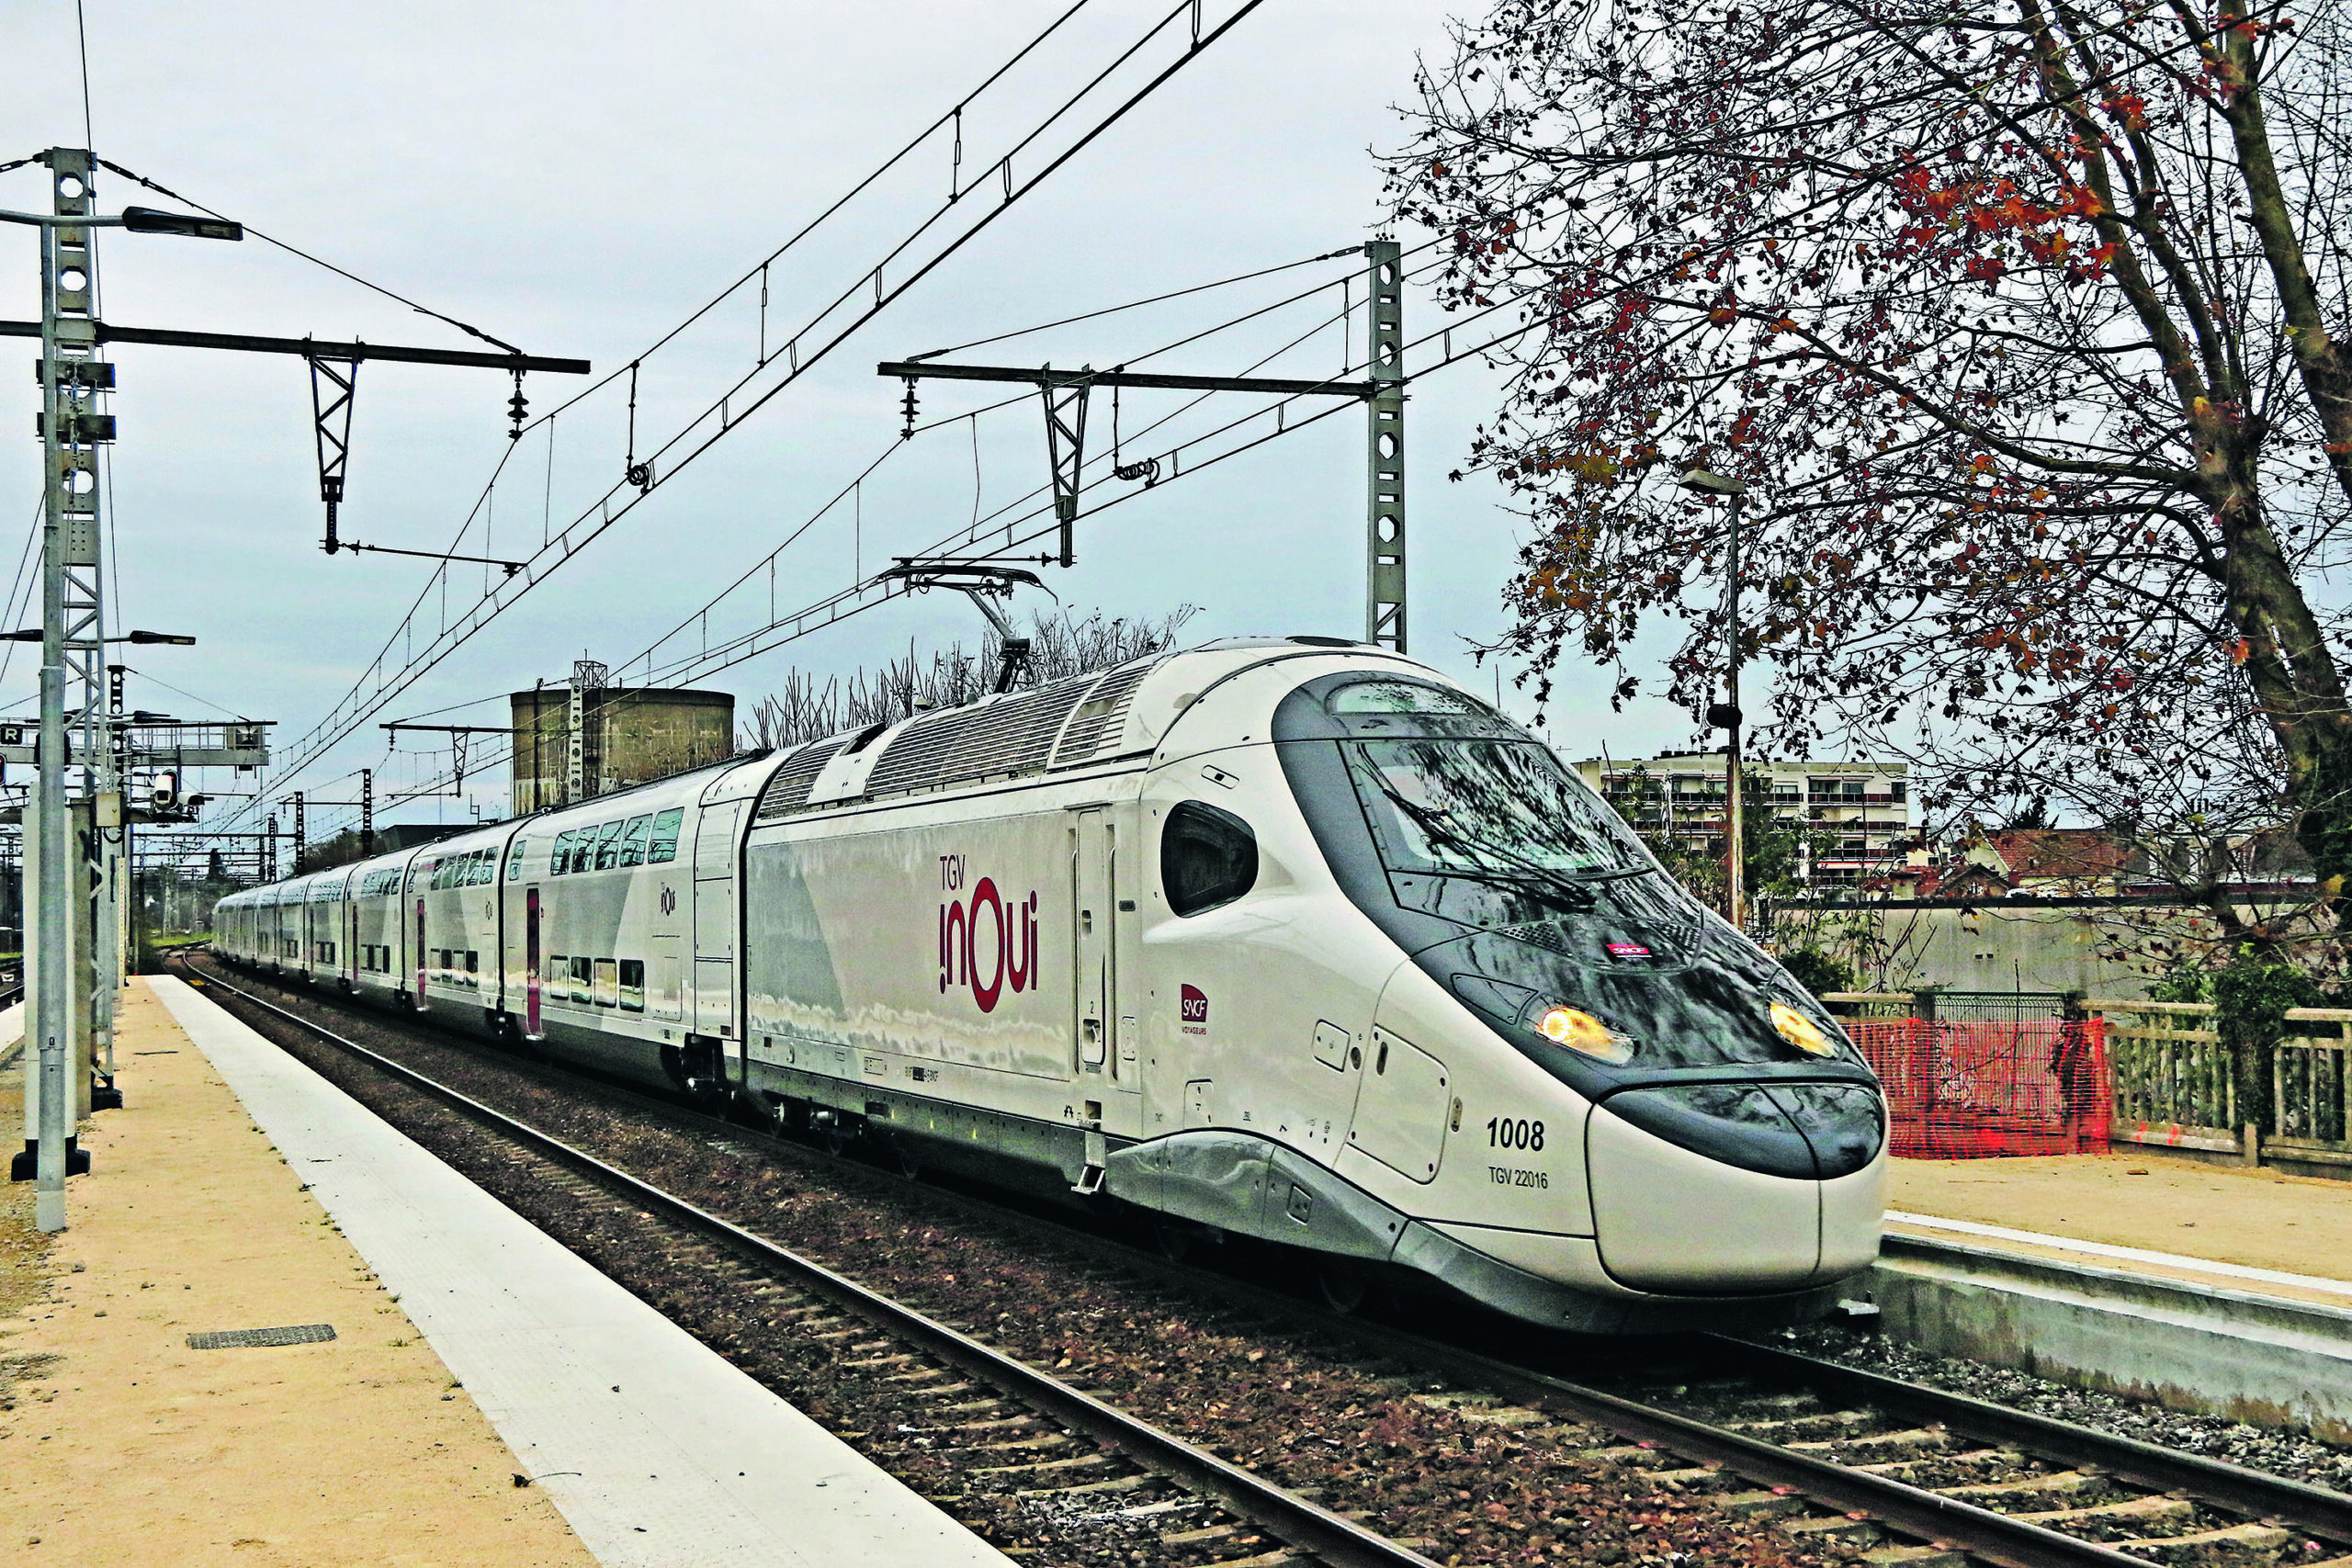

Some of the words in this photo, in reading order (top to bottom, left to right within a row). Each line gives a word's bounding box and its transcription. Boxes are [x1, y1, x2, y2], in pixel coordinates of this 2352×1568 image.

[5, 728, 17, 740] R
[939, 853, 966, 891] TGV
[1182, 998, 1206, 1017] SNCF
[1487, 1116, 1545, 1152] 1008
[1488, 1166, 1512, 1185] TGV
[1514, 1168, 1549, 1190] 22016
